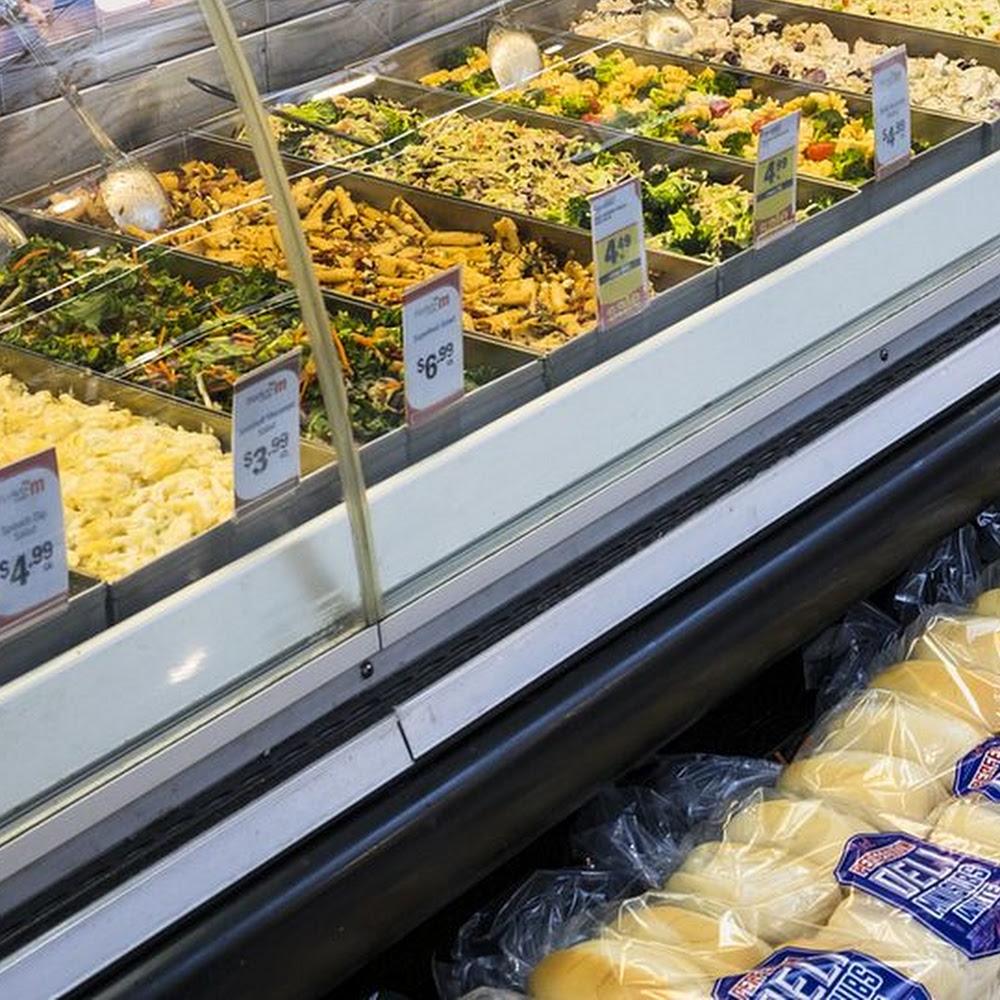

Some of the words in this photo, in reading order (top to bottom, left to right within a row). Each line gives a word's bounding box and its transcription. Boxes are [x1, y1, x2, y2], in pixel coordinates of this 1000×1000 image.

[416, 342, 455, 380] $6.99
[243, 431, 289, 476] $3.99
[0, 540, 55, 587] $4.99
[868, 846, 966, 901] DELI
